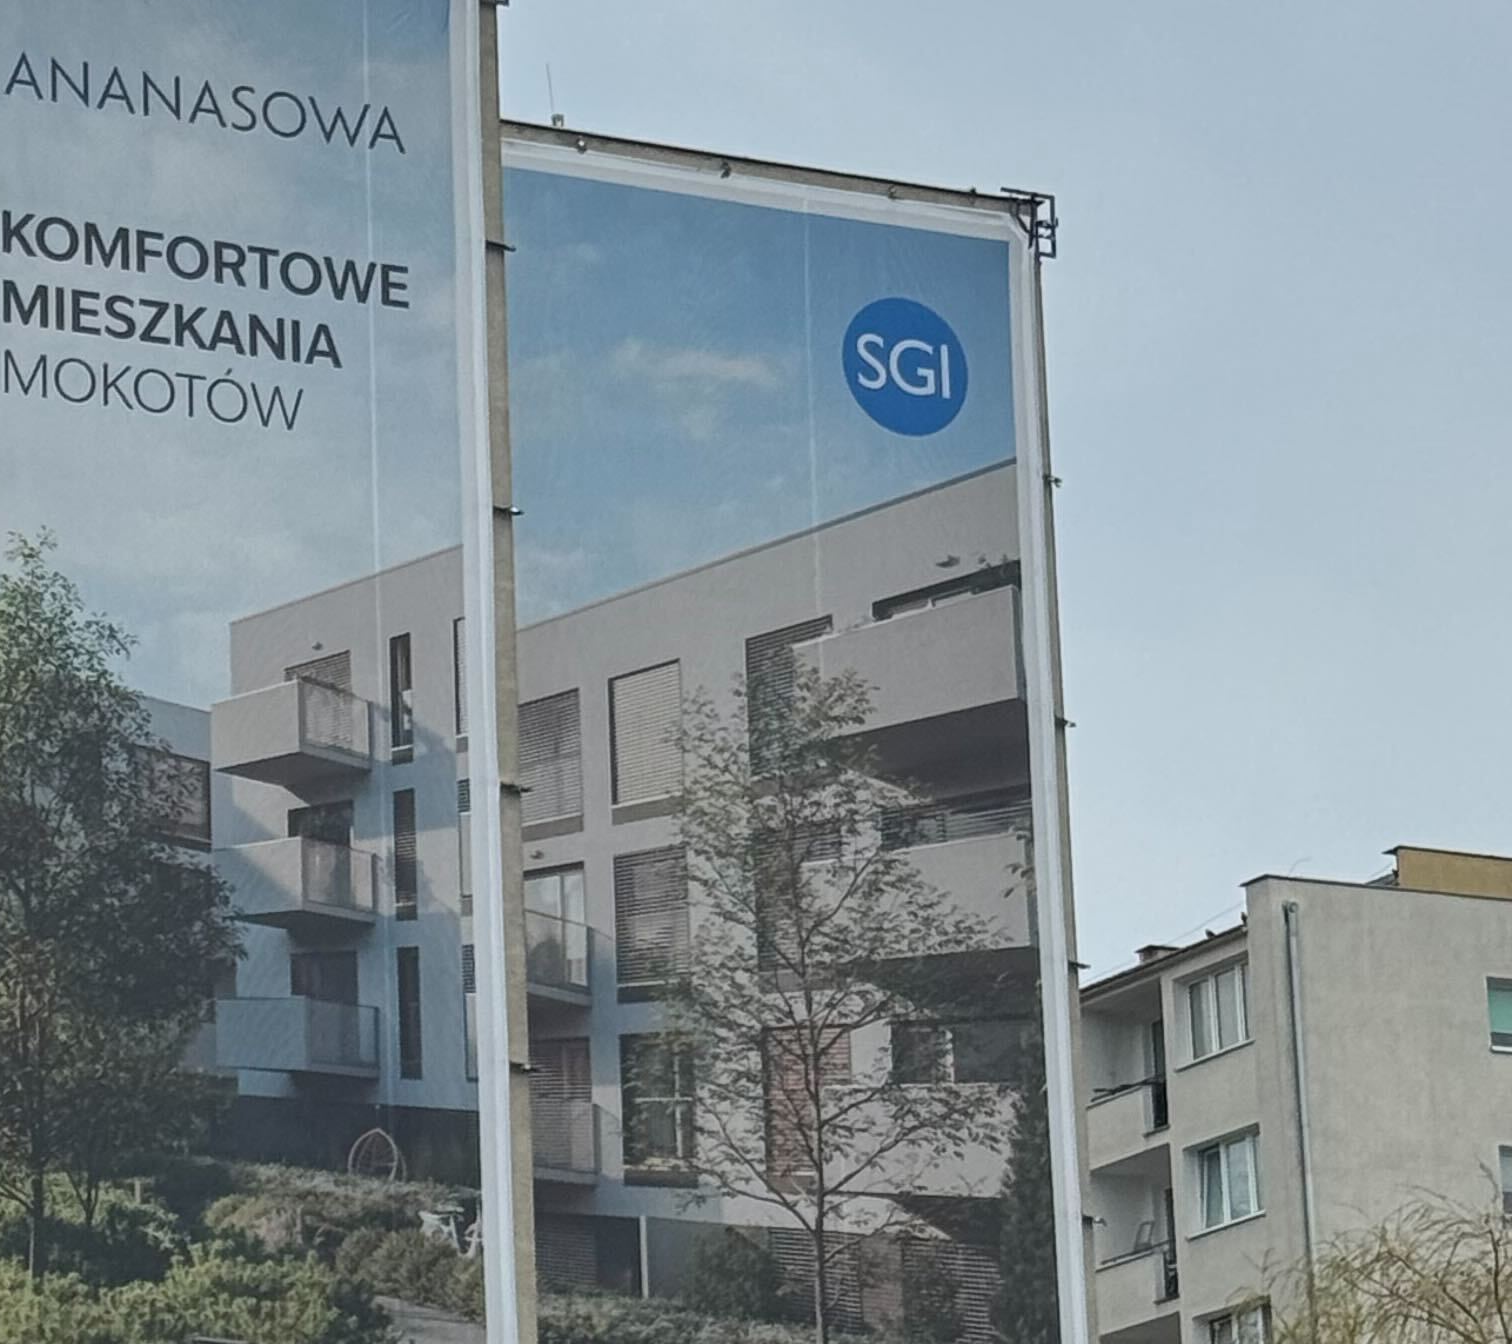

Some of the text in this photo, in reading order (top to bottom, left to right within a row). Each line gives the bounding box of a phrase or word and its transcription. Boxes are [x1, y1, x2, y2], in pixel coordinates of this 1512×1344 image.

[4, 52, 406, 154] ANANASOWA
[2, 210, 410, 309] KOMFORTOWE
[2, 279, 343, 369] MIESZKANIA
[856, 333, 952, 399] SGI
[3, 349, 303, 431] MOKOTÓW
